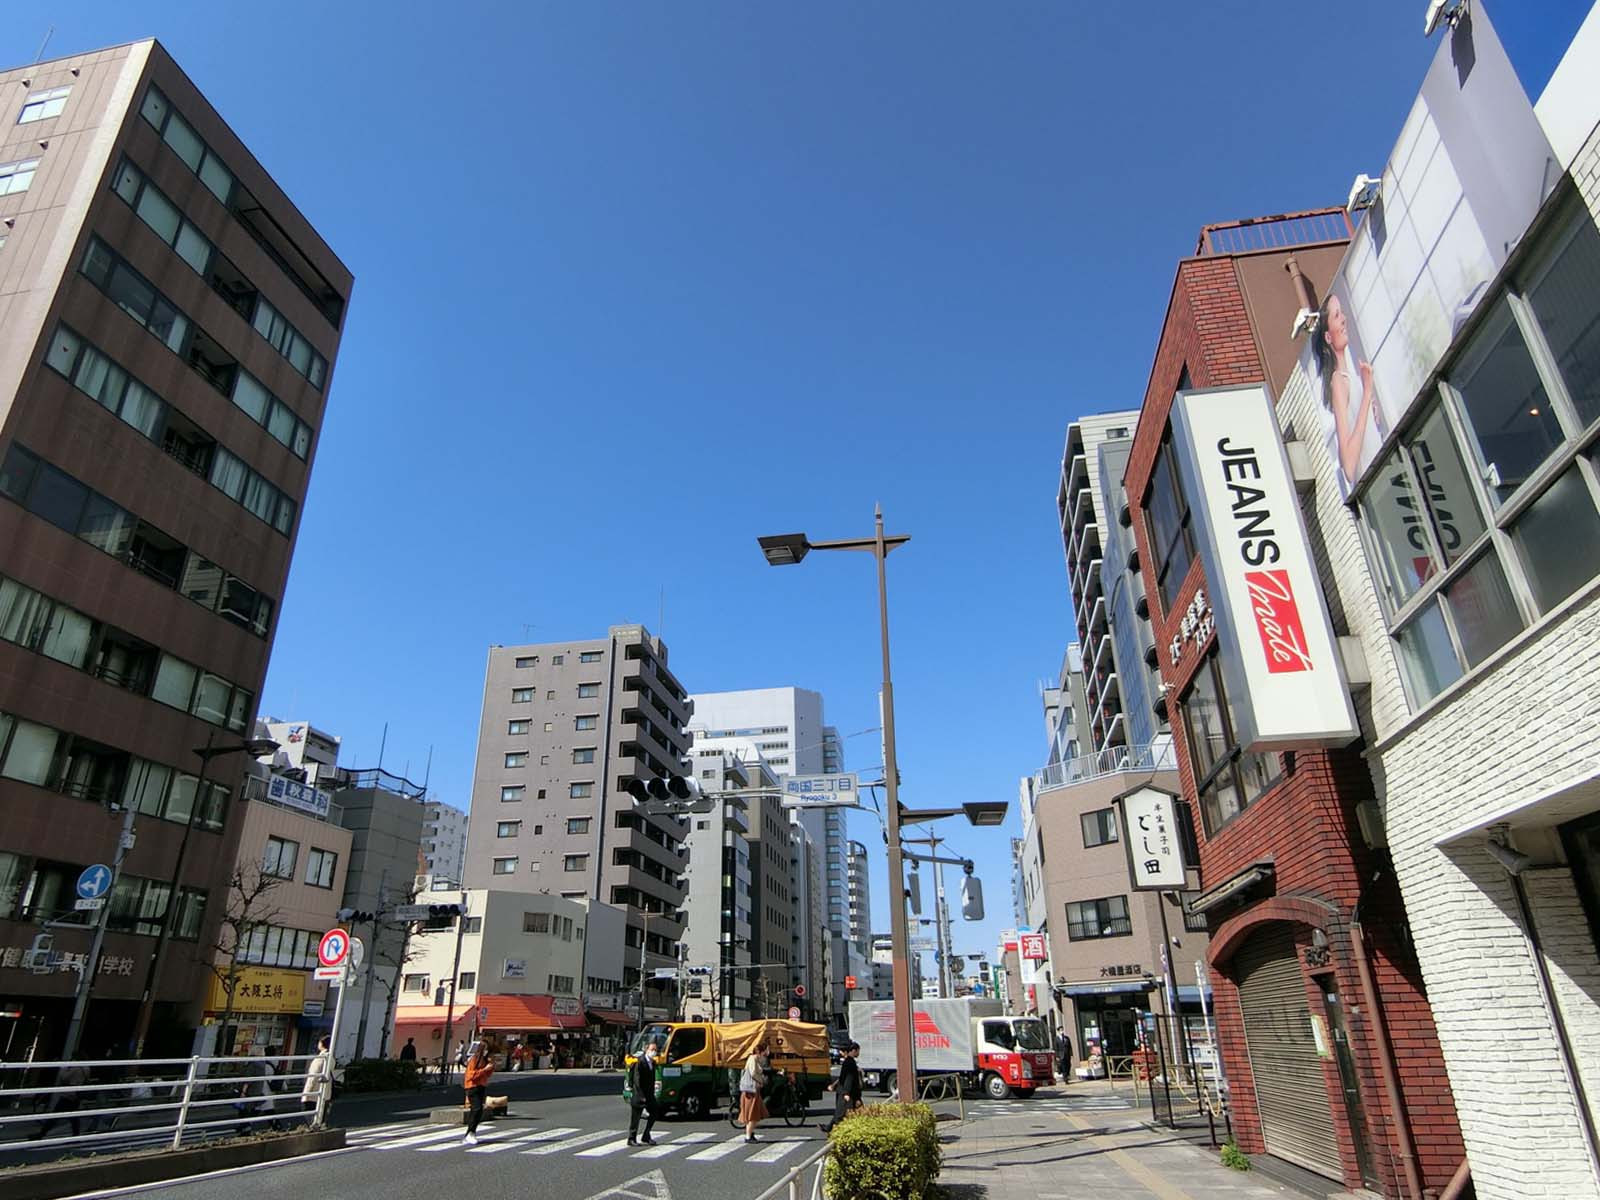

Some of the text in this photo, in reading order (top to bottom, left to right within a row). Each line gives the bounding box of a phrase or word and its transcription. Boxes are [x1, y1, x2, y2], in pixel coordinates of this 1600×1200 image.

[1217, 437, 1314, 672] JEANS mate
[787, 777, 851, 793] 両国三丁目
[800, 792, 838, 803] Ryogoku 3
[1023, 936, 1043, 957] 酒
[239, 983, 284, 999] 大阪王将
